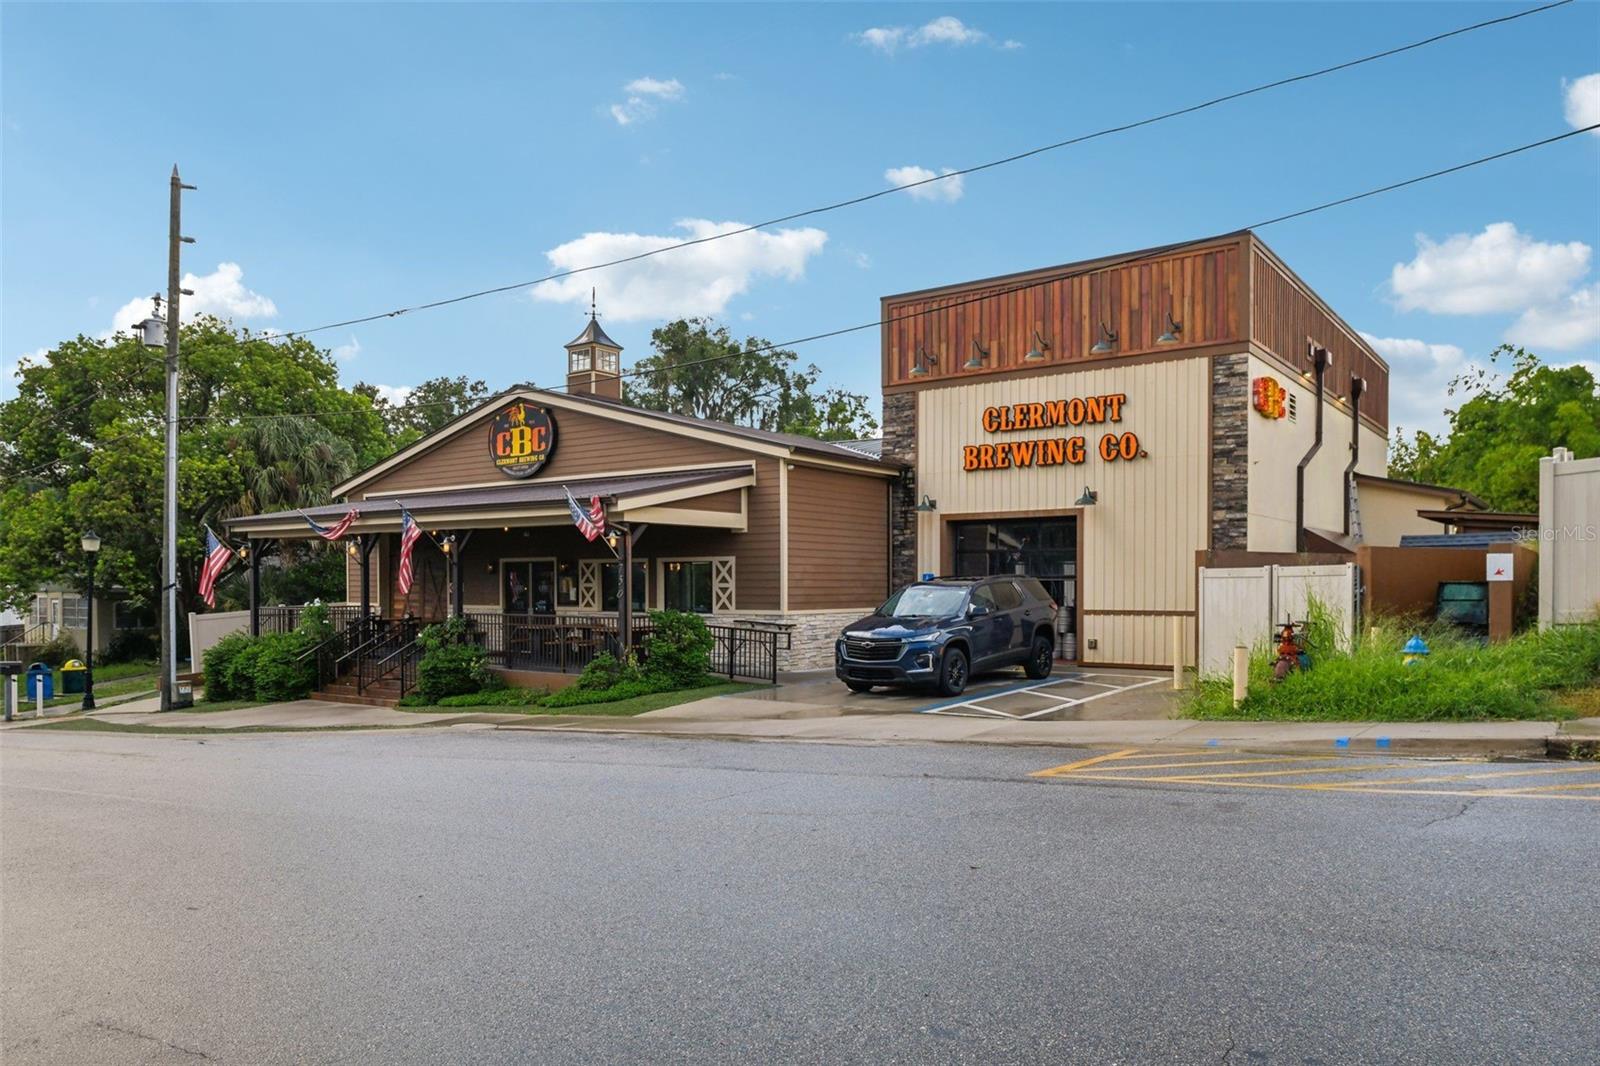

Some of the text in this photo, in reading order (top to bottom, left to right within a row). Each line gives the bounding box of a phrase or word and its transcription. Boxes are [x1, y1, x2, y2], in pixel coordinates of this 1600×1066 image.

[982, 393, 1126, 433] CLERMONT
[496, 426, 546, 456] CBC
[963, 432, 1148, 471] BREWING CO.
